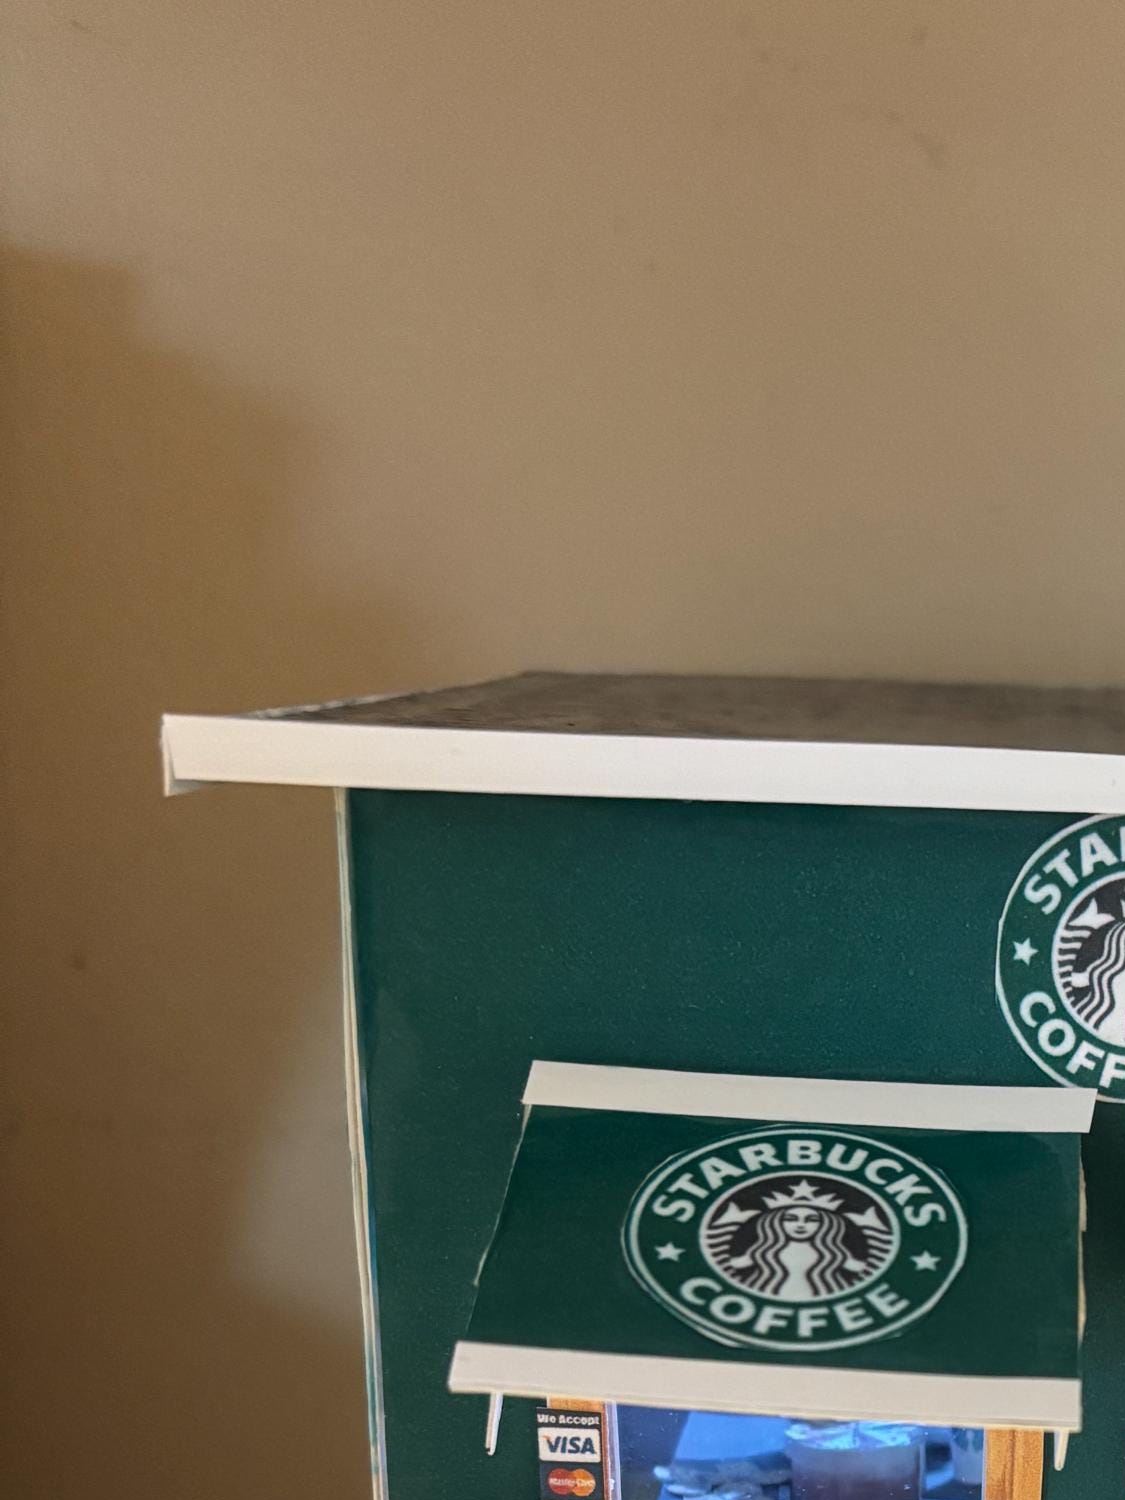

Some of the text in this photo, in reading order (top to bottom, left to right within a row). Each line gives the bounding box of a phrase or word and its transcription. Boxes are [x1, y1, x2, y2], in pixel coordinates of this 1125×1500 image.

[652, 1139, 946, 1228] STARBUCKS
[679, 1277, 910, 1338] COFFEE
[536, 1413, 600, 1426] We Accept
[543, 1436, 597, 1455] VISA
